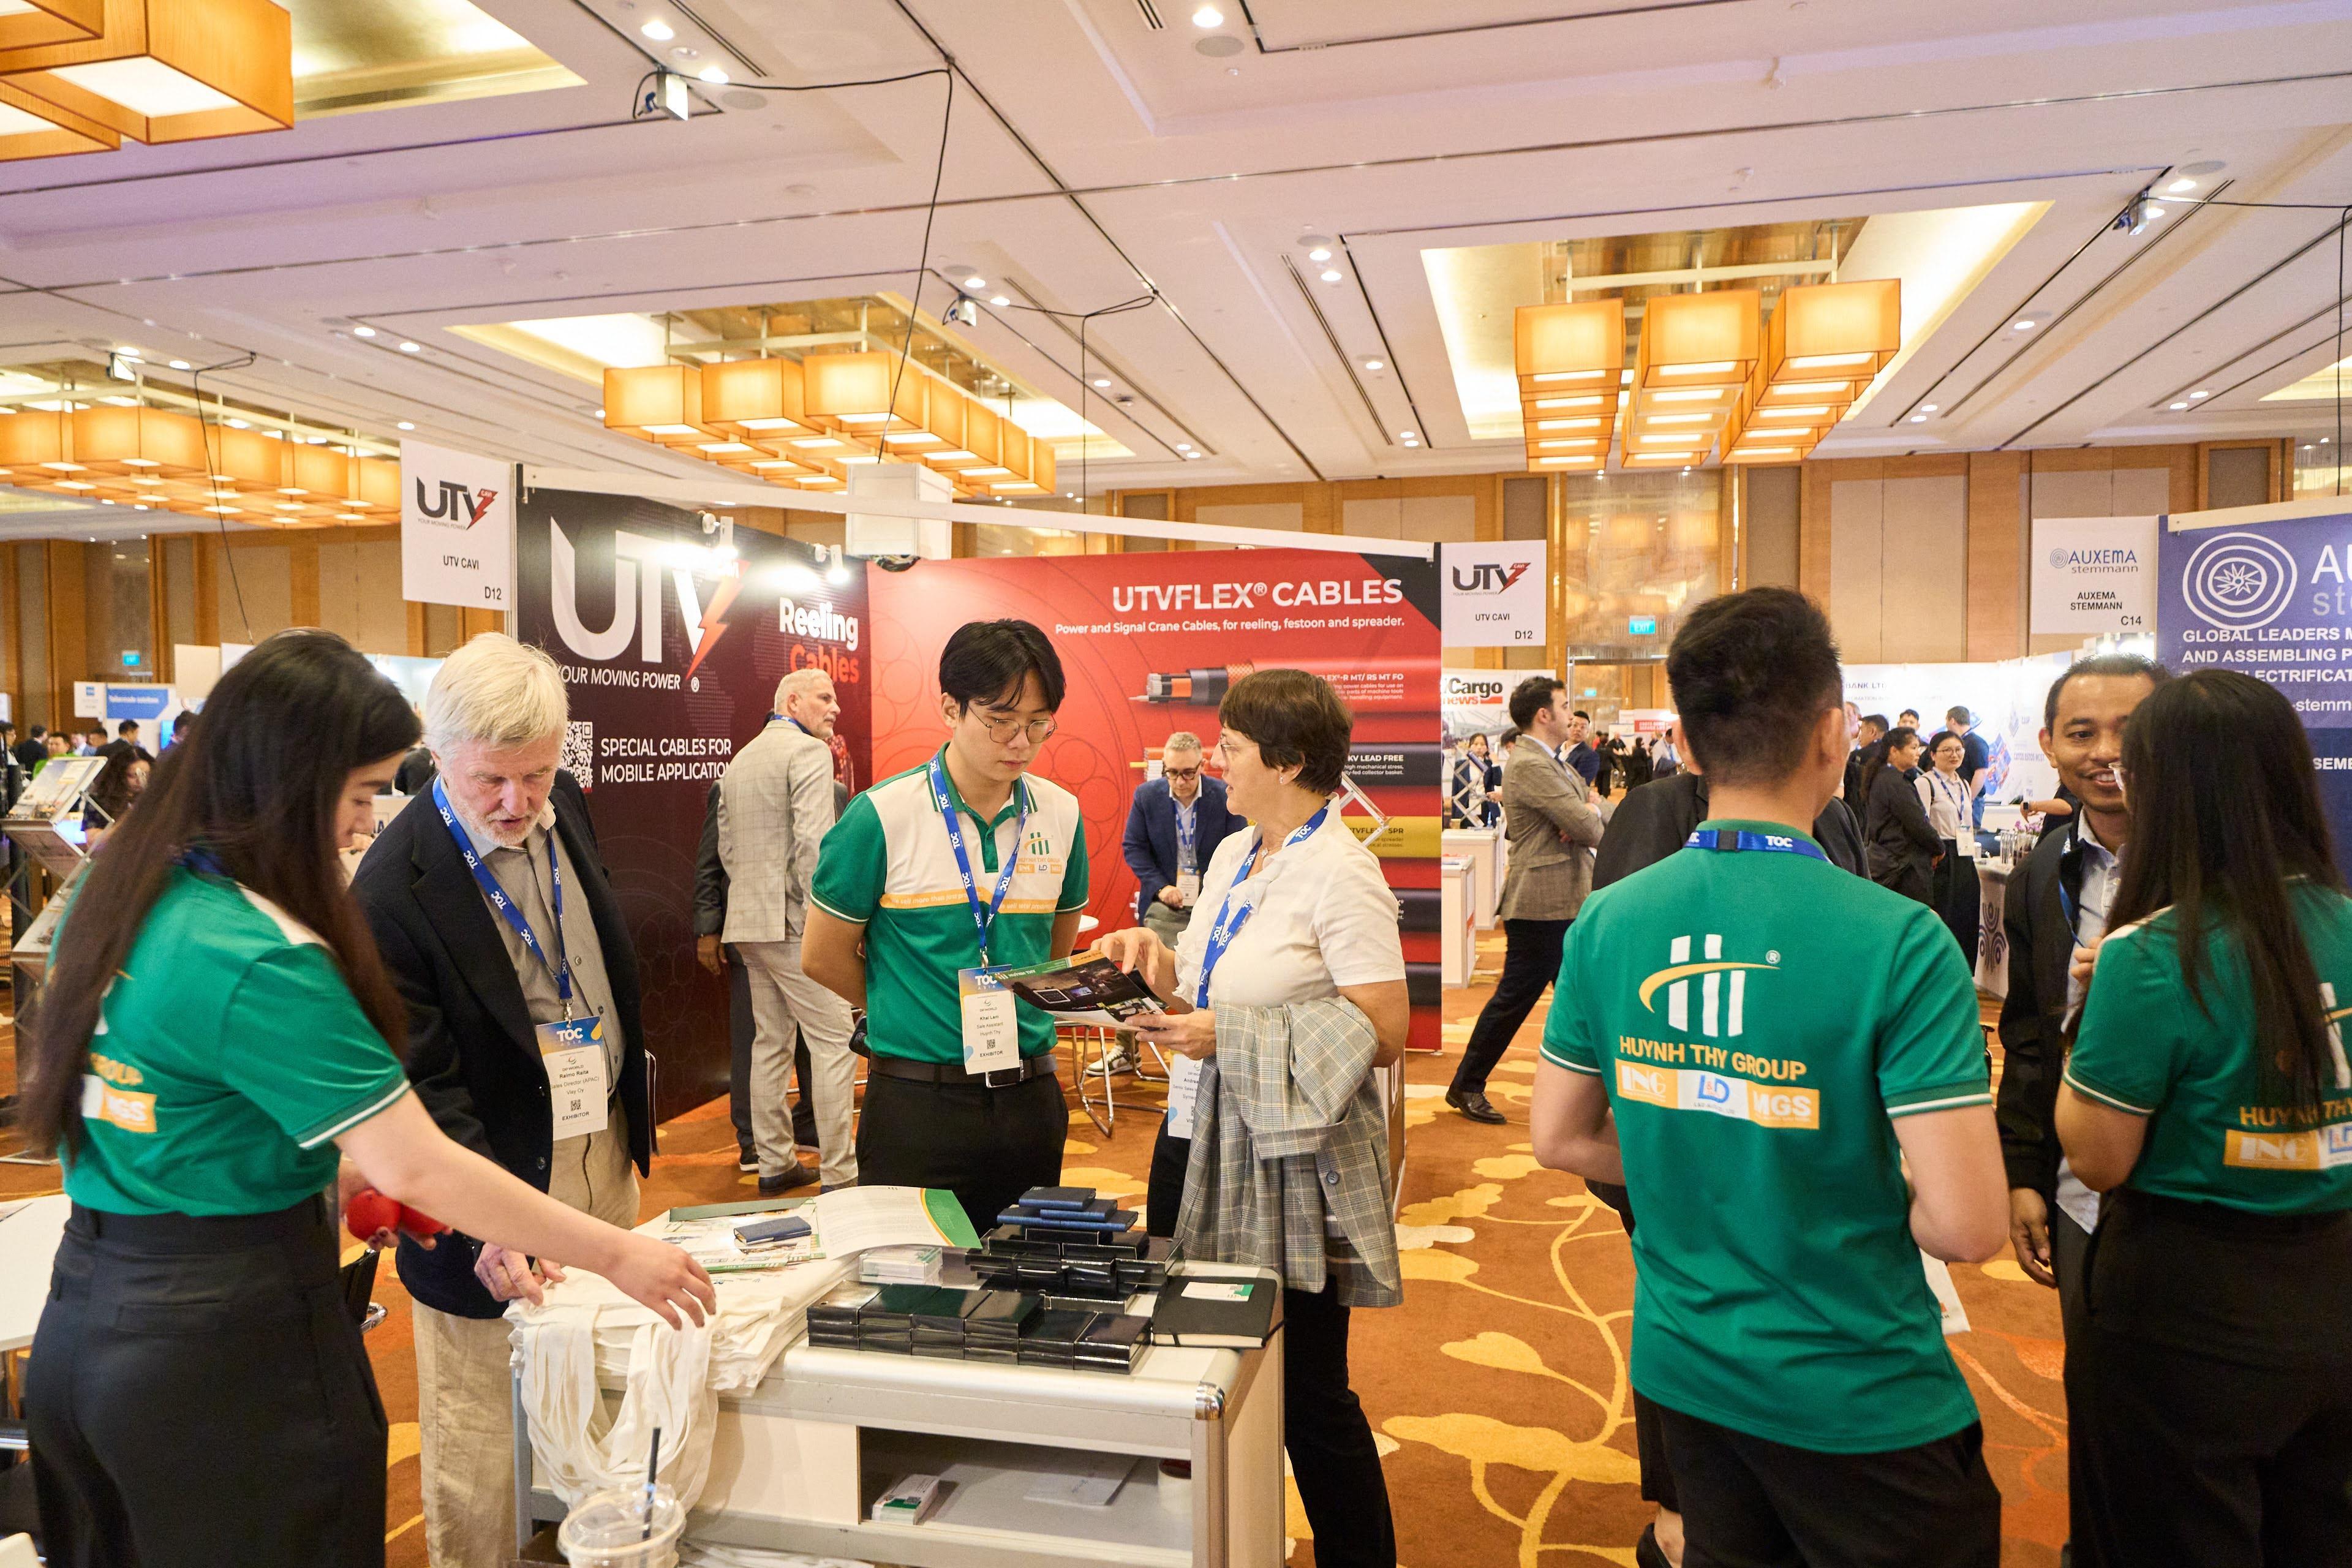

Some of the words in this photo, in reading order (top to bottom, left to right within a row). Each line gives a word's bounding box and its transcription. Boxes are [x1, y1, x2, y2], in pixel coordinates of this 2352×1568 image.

[417, 476, 495, 529] UTV
[443, 555, 459, 567] UTV
[461, 557, 480, 570] CAVI
[2071, 565, 2138, 574] stemmann
[2310, 545, 2352, 584] A
[1453, 563, 1528, 594] UTV
[484, 586, 502, 600] D12
[1272, 578, 1403, 606] CABLES
[2078, 591, 2116, 600] AUXEMA
[2071, 601, 2122, 611] STEMMANN
[780, 597, 859, 651] Reeling
[1055, 623, 1088, 635] Power
[1091, 622, 1111, 633] and
[1113, 620, 1146, 635] Signal
[1148, 621, 1180, 632] Crane
[1182, 619, 1221, 632] Cables,
[1223, 619, 1238, 630] for
[1240, 618, 1281, 631] reeling,
[1284, 617, 1325, 629] festoon
[1328, 616, 1349, 628] and
[1352, 615, 1404, 629] spreader.
[2120, 616, 2142, 625] C14
[1515, 630, 1533, 639] D12
[2182, 628, 2253, 643] GLOBAL
[2258, 627, 2340, 642] LEADERS
[790, 644, 859, 684] Cables
[2182, 650, 2218, 663] AND
[2222, 647, 2337, 663] ASSEMBLING
[590, 668, 639, 688] MOVING
[643, 672, 681, 690] POWER
[2236, 669, 2352, 683] ECTRIFICAT
[1443, 696, 1479, 705] news
[601, 737, 657, 757] SPECIAL
[660, 737, 706, 756] CABLES
[709, 737, 732, 755] FOR
[601, 763, 654, 783] MOBILE
[938, 793, 950, 810] TOC
[440, 806, 453, 827] TOC
[1295, 824, 1312, 839] TOC
[950, 832, 961, 850] TOC
[1765, 835, 1793, 848] TOC
[463, 850, 478, 870] TOC
[962, 872, 971, 889] TOC
[1000, 875, 1011, 892] TOC
[491, 890, 507, 910] TOC
[521, 928, 534, 947] TOC
[1212, 924, 1223, 942] TOC
[1219, 930, 1232, 948] TOC
[556, 1027, 584, 1042] TOC
[1619, 1035, 1685, 1063] HUYNH
[1689, 1044, 1728, 1069] THY
[1732, 1052, 1807, 1081] GROUP
[1753, 1091, 1812, 1117] MGS
[562, 1111, 590, 1121] EXHIBITOR
